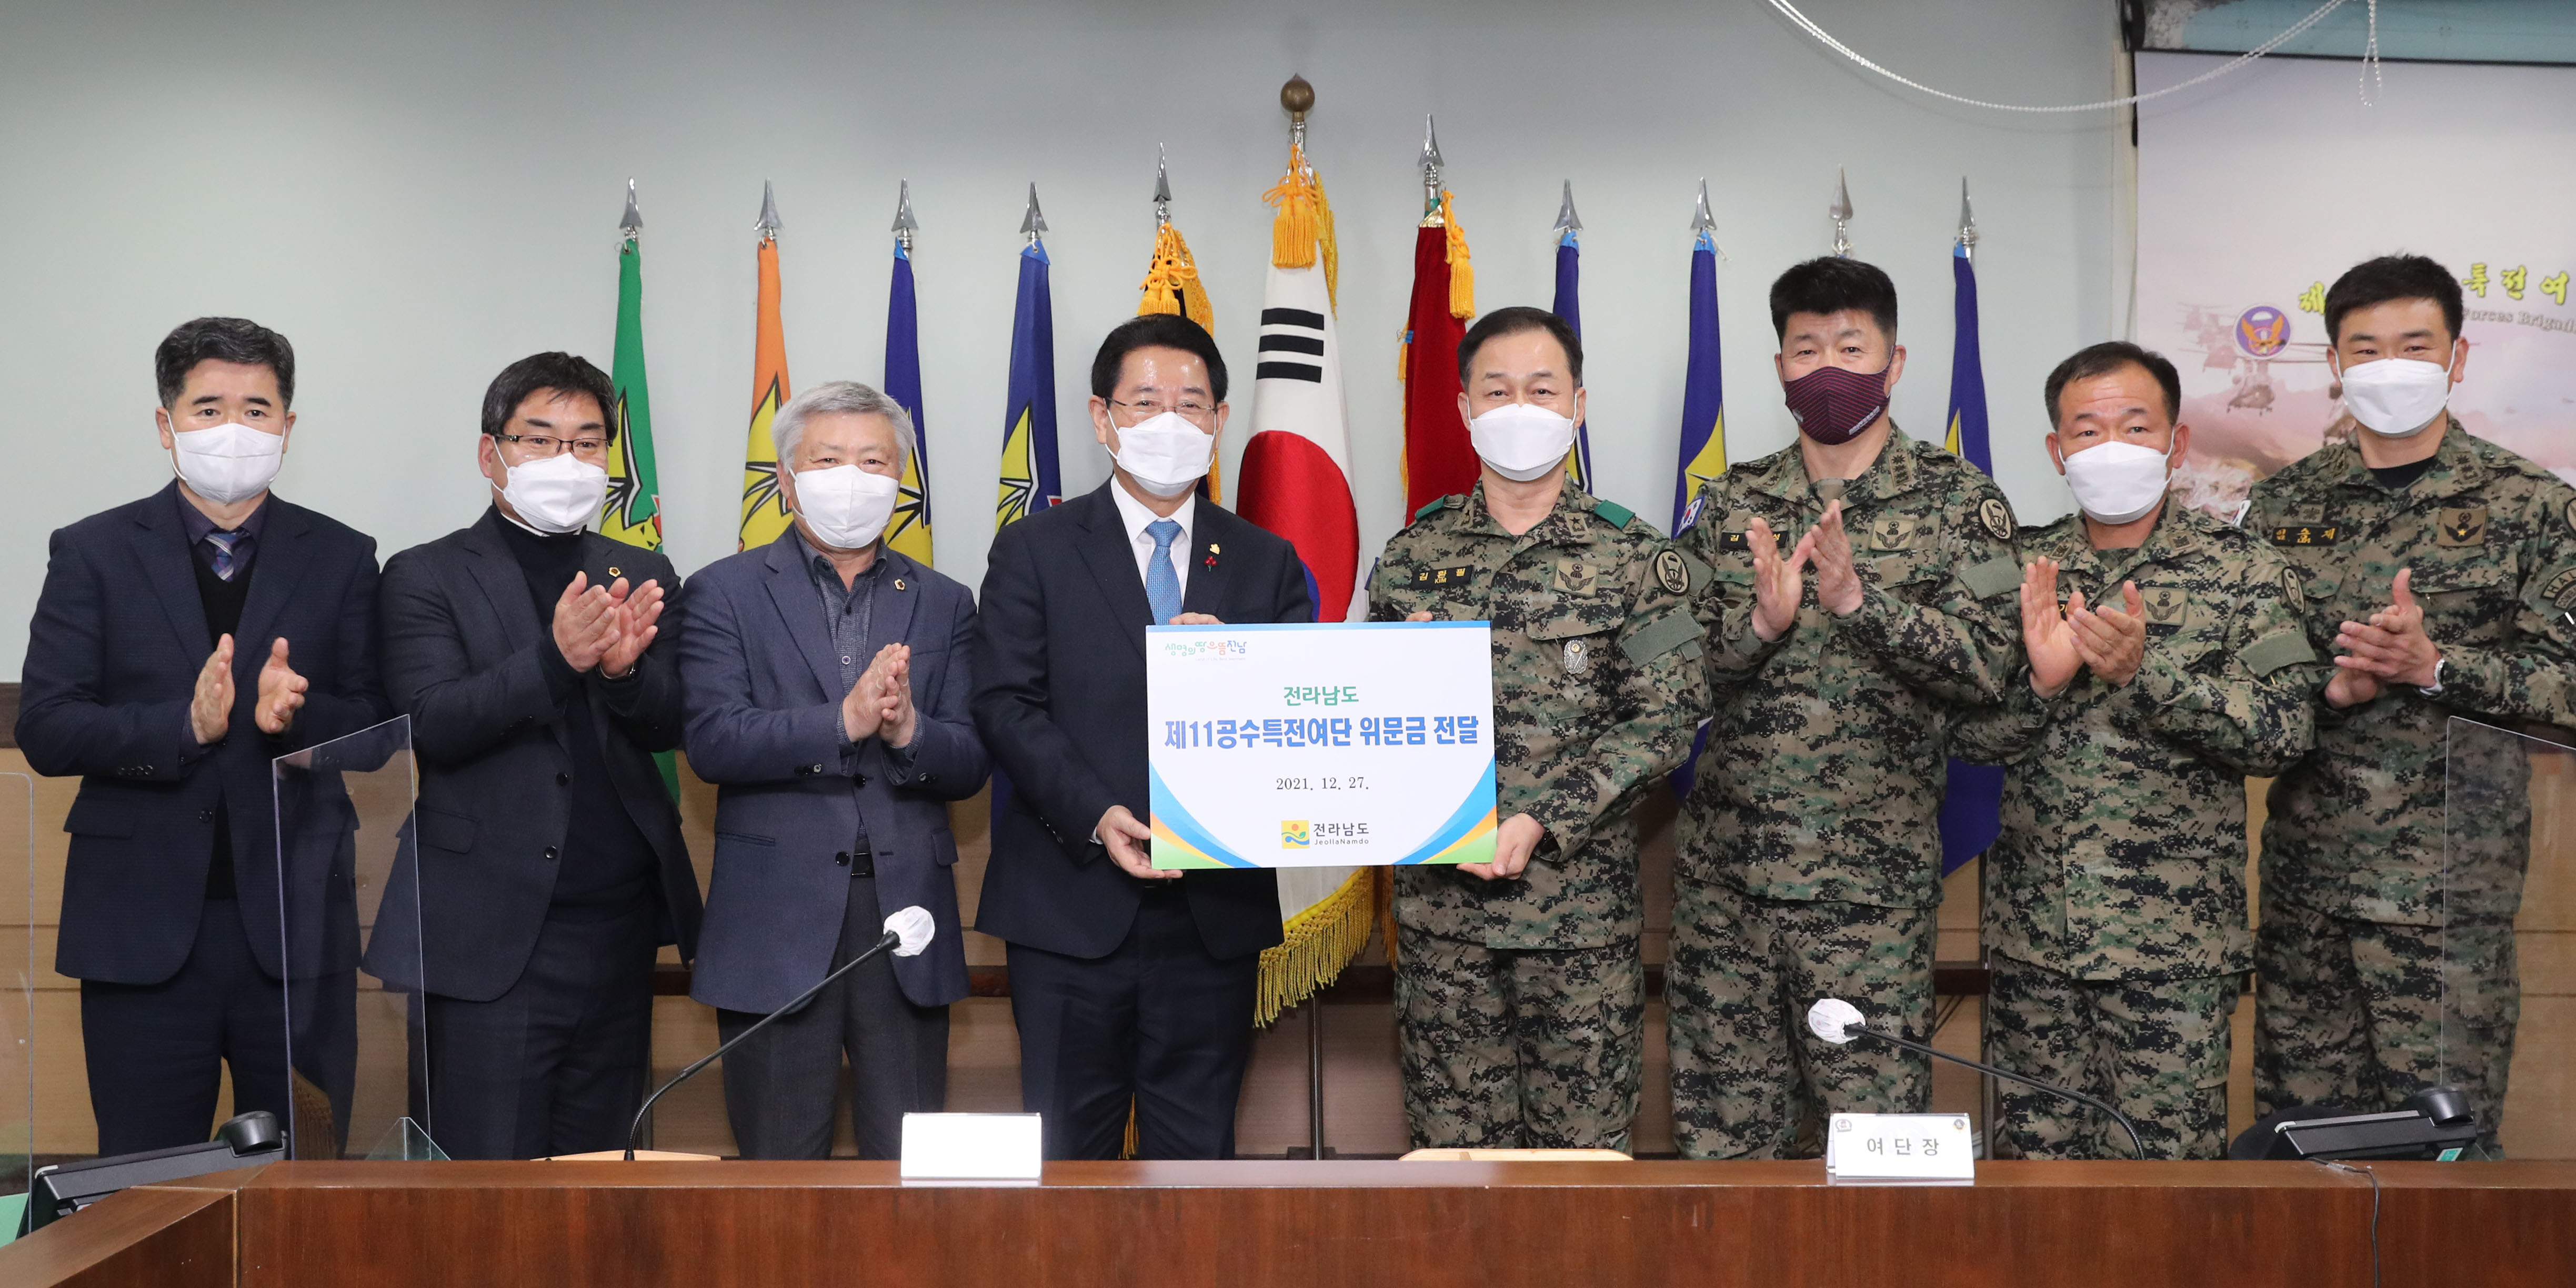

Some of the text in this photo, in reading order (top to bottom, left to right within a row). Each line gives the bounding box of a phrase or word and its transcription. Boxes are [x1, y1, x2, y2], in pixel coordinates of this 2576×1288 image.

[2518, 311, 2576, 335] Brigad
[1284, 686, 1359, 707] 전라남도
[1164, 716, 1479, 749] 제11공수특전여단 위문금 전달
[1276, 777, 1369, 791] 2021. 12. 27.
[1313, 822, 1369, 837] 전라남도
